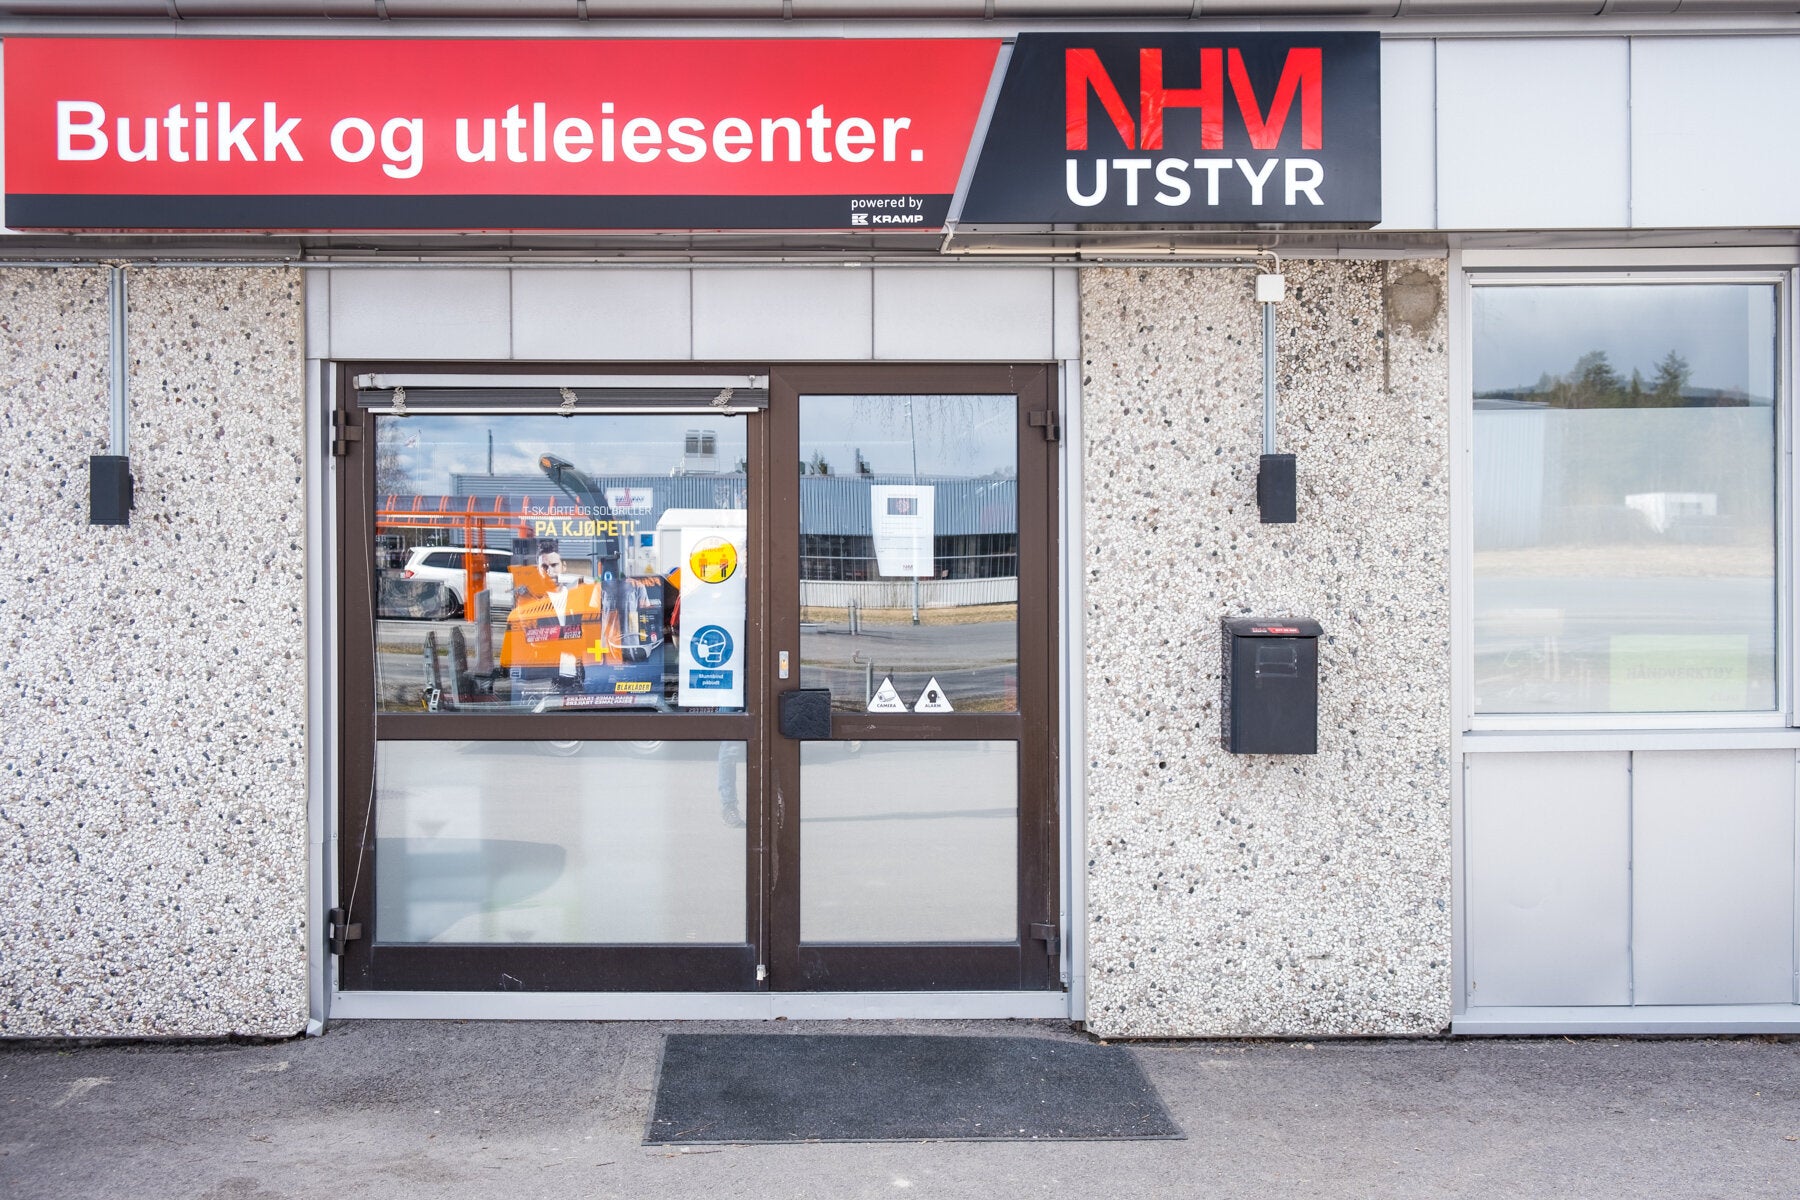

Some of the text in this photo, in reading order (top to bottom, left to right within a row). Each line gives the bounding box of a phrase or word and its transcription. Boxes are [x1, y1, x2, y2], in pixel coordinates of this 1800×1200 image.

[1065, 47, 1323, 151] NHM
[57, 100, 924, 179] Butikk og utleiesenter.
[1066, 157, 1325, 207] UTSTYR
[851, 196, 923, 211] powered by
[872, 214, 923, 224] KRAMP
[577, 506, 591, 516] OG
[593, 506, 651, 516] SOLBRILLER
